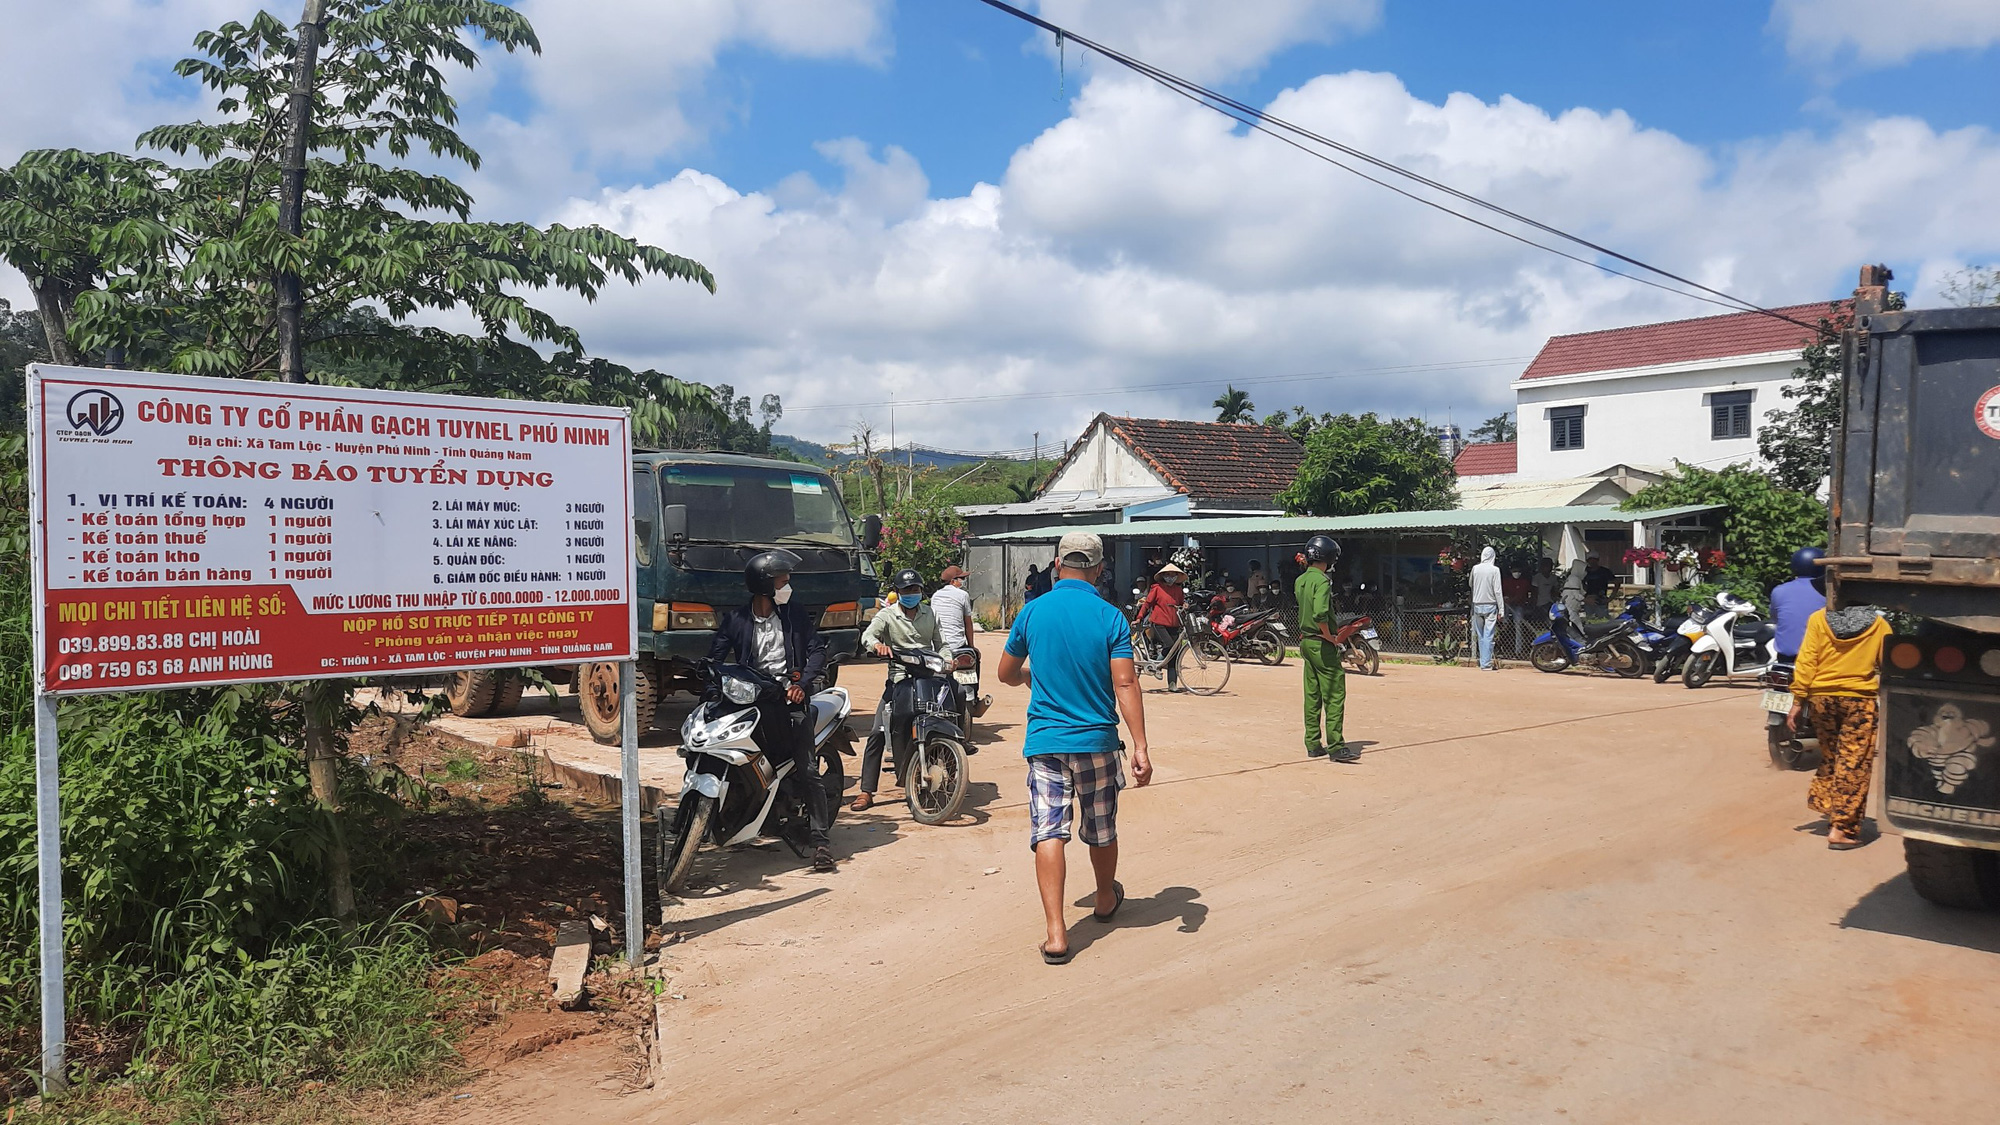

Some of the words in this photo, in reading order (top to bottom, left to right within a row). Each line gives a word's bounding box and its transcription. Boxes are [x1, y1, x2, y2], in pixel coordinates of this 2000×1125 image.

[138, 397, 211, 425] CÔNG
[220, 406, 249, 427] TY
[258, 401, 291, 429] CỔ
[299, 406, 363, 433] PHẦN
[371, 415, 430, 440] GẠCH
[437, 419, 513, 441] TUYNEL
[519, 422, 558, 444] PHÚ
[564, 427, 610, 446] NINH
[1987, 405, 2000, 418] T
[188, 435, 212, 448] Địa
[216, 436, 242, 448] chỉ:
[246, 438, 264, 449] Xã
[268, 439, 295, 450] Tam
[299, 440, 322, 453] Lộc
[335, 442, 373, 455] Huyện
[377, 444, 399, 455] Phú
[404, 446, 430, 456] Ninh
[442, 447, 466, 457] Tỉnh
[470, 448, 504, 460] Quảng
[507, 450, 532, 460] Nam
[157, 455, 281, 480] THÔNG
[291, 460, 358, 482] BÁO
[367, 458, 468, 485] TUYỂN
[477, 469, 555, 491] DỤNG
[67, 494, 85, 507] 1.
[99, 494, 117, 510] VỊ
[124, 492, 154, 507] TRÍ
[161, 490, 187, 507] KẾ
[192, 492, 247, 509] TOÁN:
[264, 497, 275, 509] 4
[280, 496, 334, 510] NGƯỜI
[432, 501, 442, 511] 2.
[446, 500, 463, 511] LÁI
[467, 500, 490, 511] MÁY
[493, 501, 520, 512] MÚC:
[566, 503, 572, 513] 3
[574, 502, 604, 513] NGƯỜI
[82, 510, 110, 526] Kế
[114, 512, 158, 526] toán
[164, 511, 206, 529] tổng
[212, 514, 246, 529] hợp
[268, 515, 277, 527] 1
[284, 515, 332, 529] người
[432, 519, 442, 529] 3.
[446, 518, 463, 529] LÁI
[467, 518, 490, 530] MÁY
[493, 519, 515, 530] XÚC
[518, 519, 538, 532] LẬT:
[565, 521, 570, 530] 1
[574, 520, 604, 530] NGƯỜI
[82, 529, 110, 545] Kế
[115, 531, 158, 545] toán
[164, 529, 208, 545] thuế
[268, 532, 277, 544] 1
[284, 532, 332, 547] người
[432, 537, 443, 547] 4.
[446, 536, 463, 547] LÁI
[467, 537, 480, 547] XE
[484, 536, 517, 547] NÂNG:
[566, 537, 572, 547] 3
[574, 536, 604, 547] NGƯỜI
[83, 548, 110, 564] Kế
[115, 550, 158, 563] toán
[165, 550, 200, 563] kho
[268, 550, 277, 562] 1
[284, 549, 332, 565] người
[433, 555, 443, 566] 5.
[447, 553, 477, 566] QUẢN
[480, 552, 505, 565] ĐỐC:
[566, 554, 571, 563] 1
[575, 554, 605, 564] NGƯỜI
[83, 567, 111, 583] Kế
[116, 569, 159, 582] toán
[165, 568, 200, 581] bán
[207, 568, 252, 582] hàng
[269, 568, 277, 580] 1
[284, 567, 332, 581] người
[433, 573, 443, 584] 6.
[447, 571, 476, 583] GIÁM
[479, 570, 500, 583] ĐỐC
[504, 569, 528, 582] ĐIỀU
[531, 571, 561, 582] HÀNH:
[567, 572, 572, 581] 1
[576, 571, 606, 581] NGƯỜI
[58, 602, 97, 626] MỌI
[103, 601, 136, 621] CHI
[142, 593, 179, 620] TIẾT
[185, 595, 225, 618] LIÊN
[230, 594, 252, 620] HỆ
[258, 590, 286, 616] SỐ:
[313, 593, 343, 610] MỨC
[348, 592, 390, 609] LƯƠNG
[396, 593, 420, 608] THU
[423, 590, 458, 609] NHẬP
[461, 590, 478, 606] TỪ
[480, 591, 544, 605] 6.000.000Đ
[554, 589, 620, 603] 12.000.000Đ
[343, 617, 377, 635] NỘP
[382, 614, 404, 631] HỒ
[408, 614, 430, 630] SƠ
[434, 614, 472, 632] TRỰC
[476, 610, 508, 627] TIẾP
[512, 612, 534, 628] TẠI
[537, 609, 575, 624] CÔNG
[579, 610, 595, 622] TY
[58, 632, 184, 655] 039.899.83.88
[188, 631, 217, 650] CHỊ
[222, 627, 260, 646] HOÀI
[374, 634, 422, 648] Phỏng
[426, 630, 452, 645] vấn
[456, 631, 474, 644] và
[477, 630, 512, 645] nhận
[515, 628, 544, 644] việc
[547, 628, 579, 640] ngay
[321, 658, 339, 667] ĐC:
[341, 655, 369, 666] THÔN
[372, 656, 377, 664] 1
[388, 654, 402, 663] XÃ
[404, 653, 425, 662] TAM
[427, 651, 446, 663] LỘC
[455, 649, 486, 660] HUYỆN
[488, 647, 507, 658] PHÚ
[509, 647, 532, 657] NINH
[540, 643, 560, 654] TỈNH
[562, 642, 591, 654] QUẢNG
[593, 642, 613, 651] NAM
[59, 663, 93, 681] 098
[98, 661, 131, 679] 759
[136, 660, 157, 677] 63
[162, 658, 184, 675] 68
[189, 656, 223, 674] ANH
[228, 652, 273, 671] HÙNG
